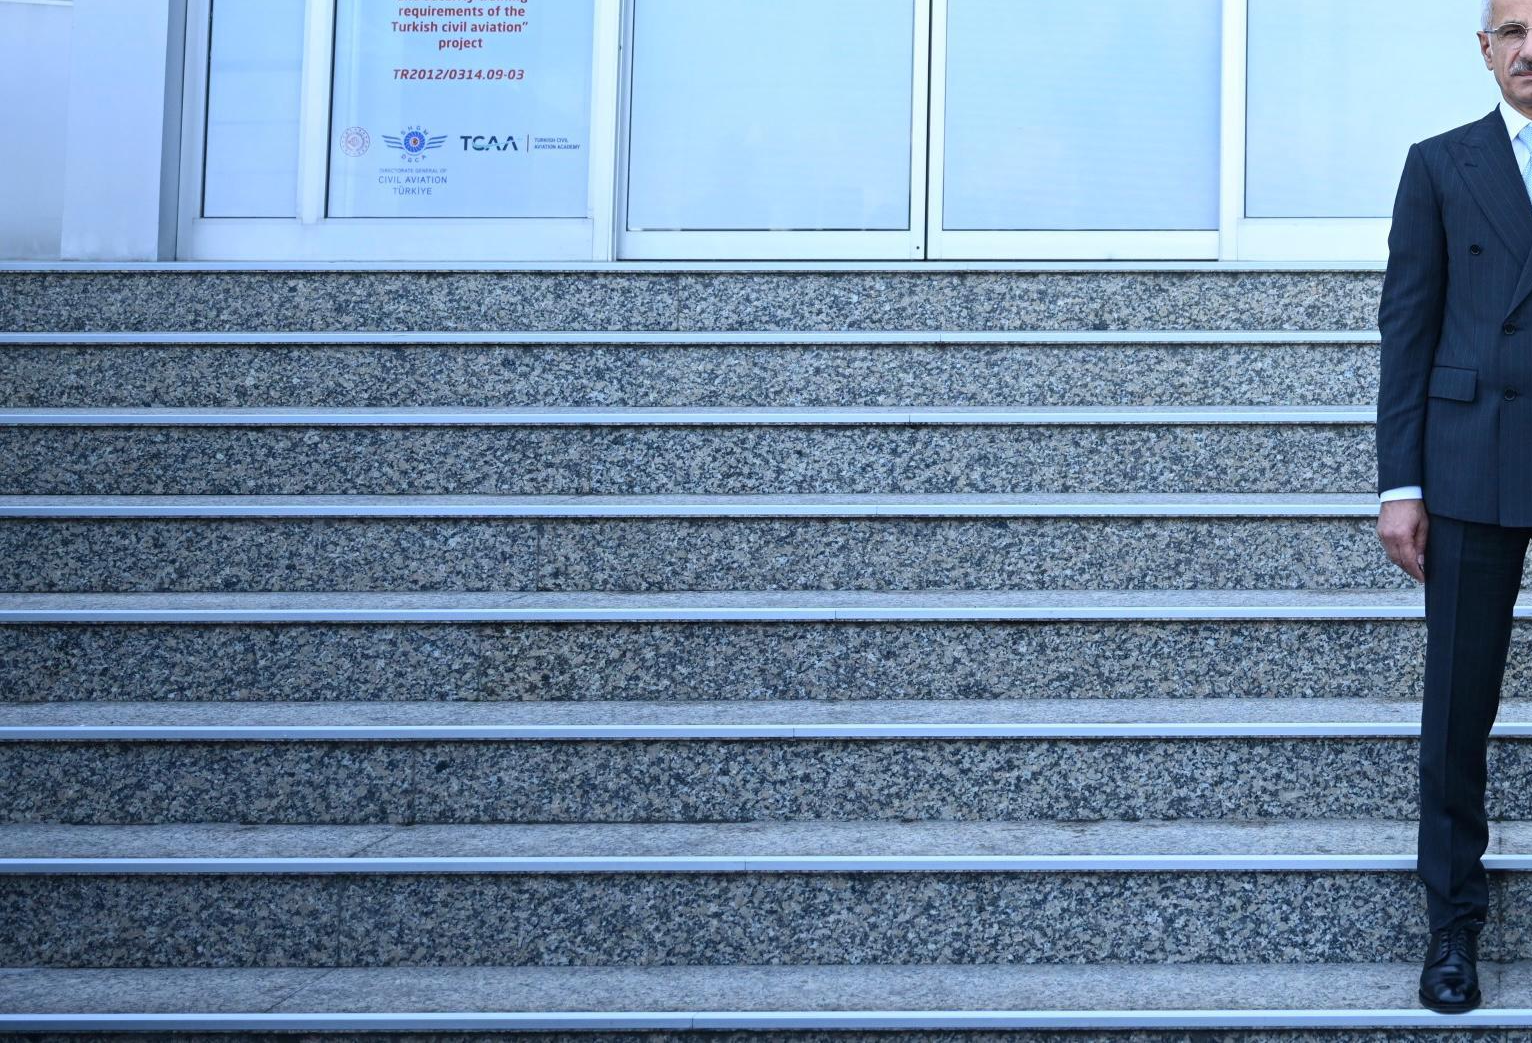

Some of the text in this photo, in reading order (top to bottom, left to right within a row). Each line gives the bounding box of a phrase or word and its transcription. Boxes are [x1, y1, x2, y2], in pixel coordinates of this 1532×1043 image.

[399, 5, 526, 19] requirements of the
[391, 21, 438, 32] Turkish
[441, 21, 467, 32] civil
[438, 38, 483, 51] project
[393, 69, 525, 80] TR2012/0314.09-03
[460, 135, 518, 151] TCAA
[378, 176, 448, 184] CIVIL AVIATION
